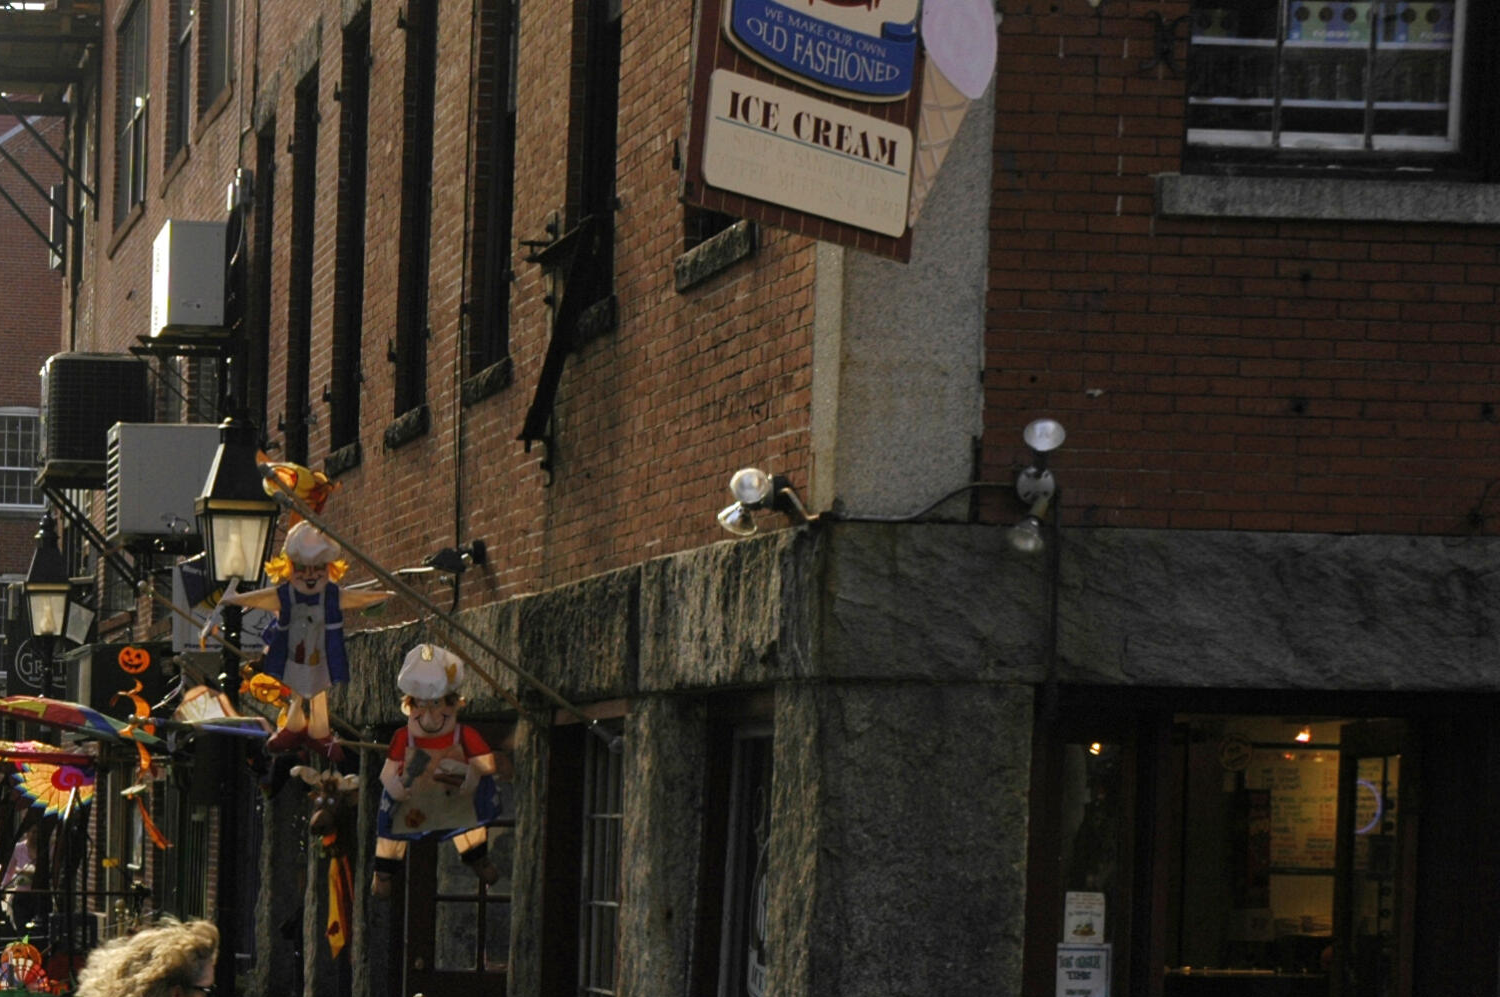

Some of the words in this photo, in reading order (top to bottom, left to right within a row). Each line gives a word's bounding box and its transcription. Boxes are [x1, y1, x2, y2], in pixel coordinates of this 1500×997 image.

[746, 17, 788, 53] OLD
[792, 33, 900, 83] FASHIONED
[764, 6, 784, 22] WE
[787, 14, 825, 37] MAKE
[827, 28, 853, 47] OUR
[855, 38, 887, 58] OWN
[728, 90, 780, 133] ICE
[792, 110, 898, 168] CREAM
